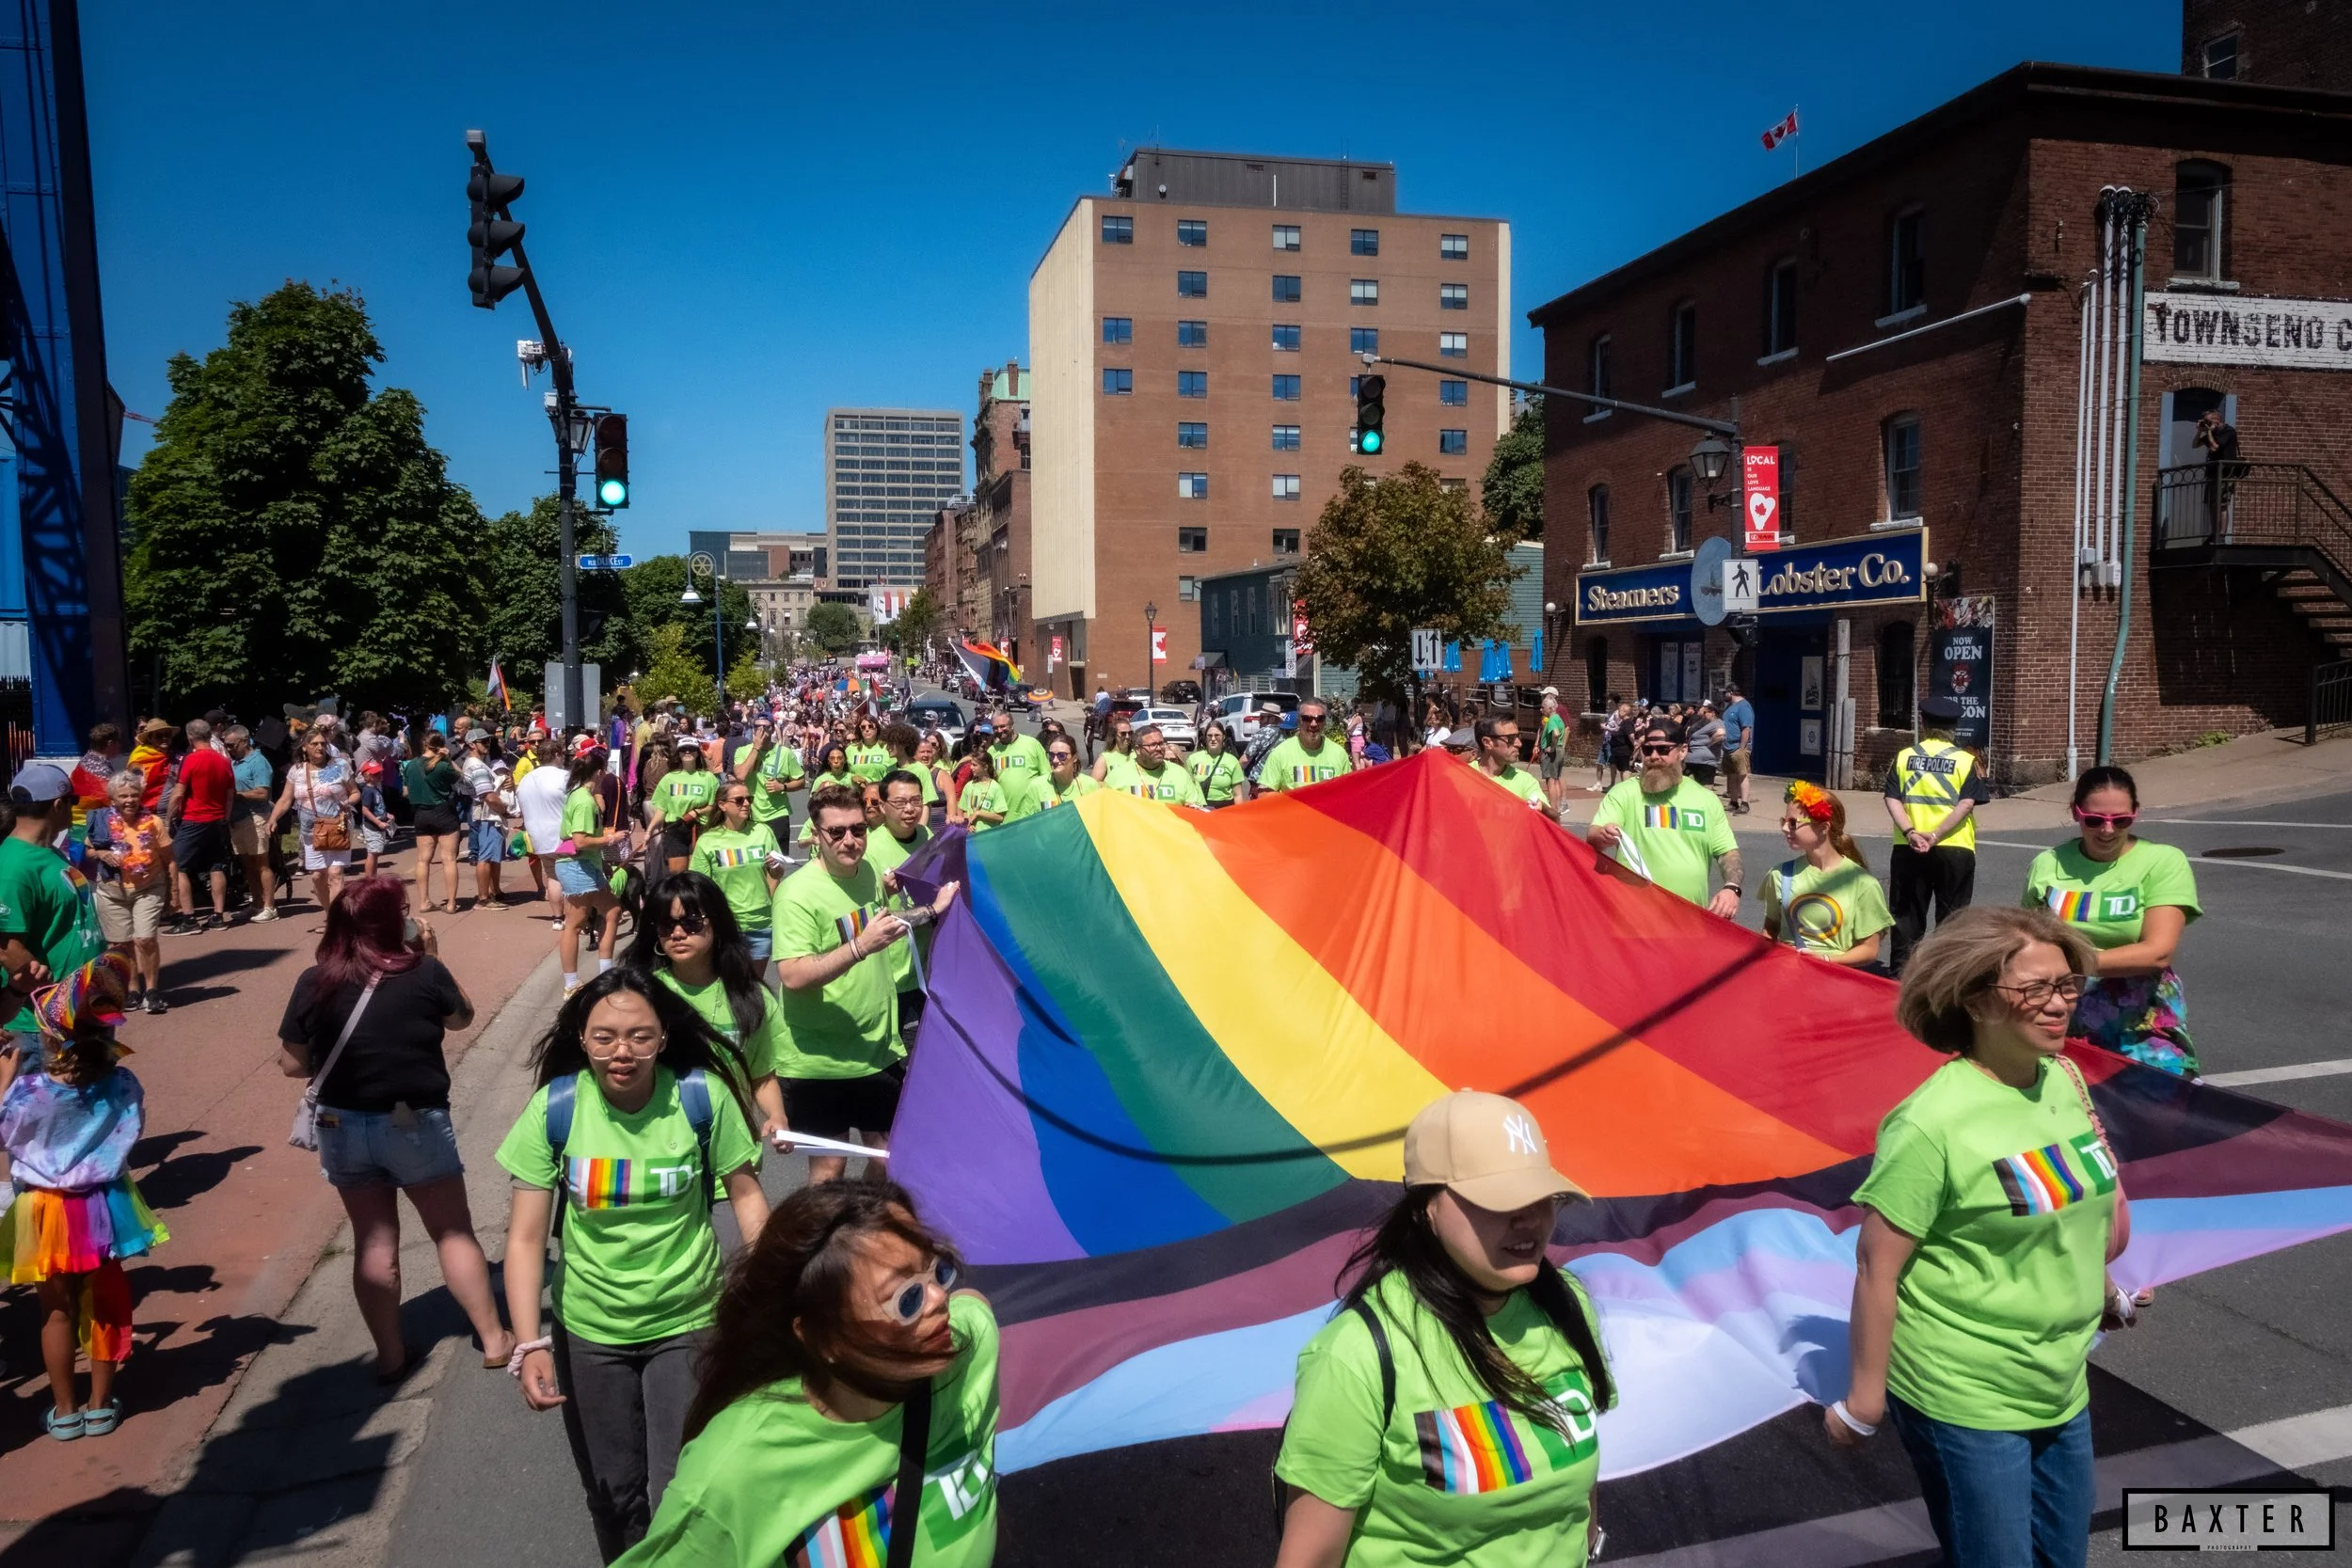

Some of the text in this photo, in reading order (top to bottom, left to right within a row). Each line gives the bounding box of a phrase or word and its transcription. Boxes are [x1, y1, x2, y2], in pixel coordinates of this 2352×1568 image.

[2147, 302, 2325, 350] TOWNSEND
[1746, 455, 1775, 465] LOCAL
[596, 557, 618, 565] DUKE
[1587, 553, 1912, 612] Steamers Lobster Co.
[1952, 637, 1973, 645] NOW
[1944, 645, 1983, 660] OPEN
[1960, 696, 1979, 705] THE
[1012, 756, 1025, 766] TD
[1908, 756, 1955, 773] FIRE POLICE
[692, 785, 704, 795] TD
[1158, 786, 1174, 797] TD
[1683, 812, 1704, 828] TD
[748, 847, 764, 859] TD
[2104, 895, 2137, 916] TD
[1502, 1114, 1538, 1155] NY
[649, 1164, 694, 1197] TD
